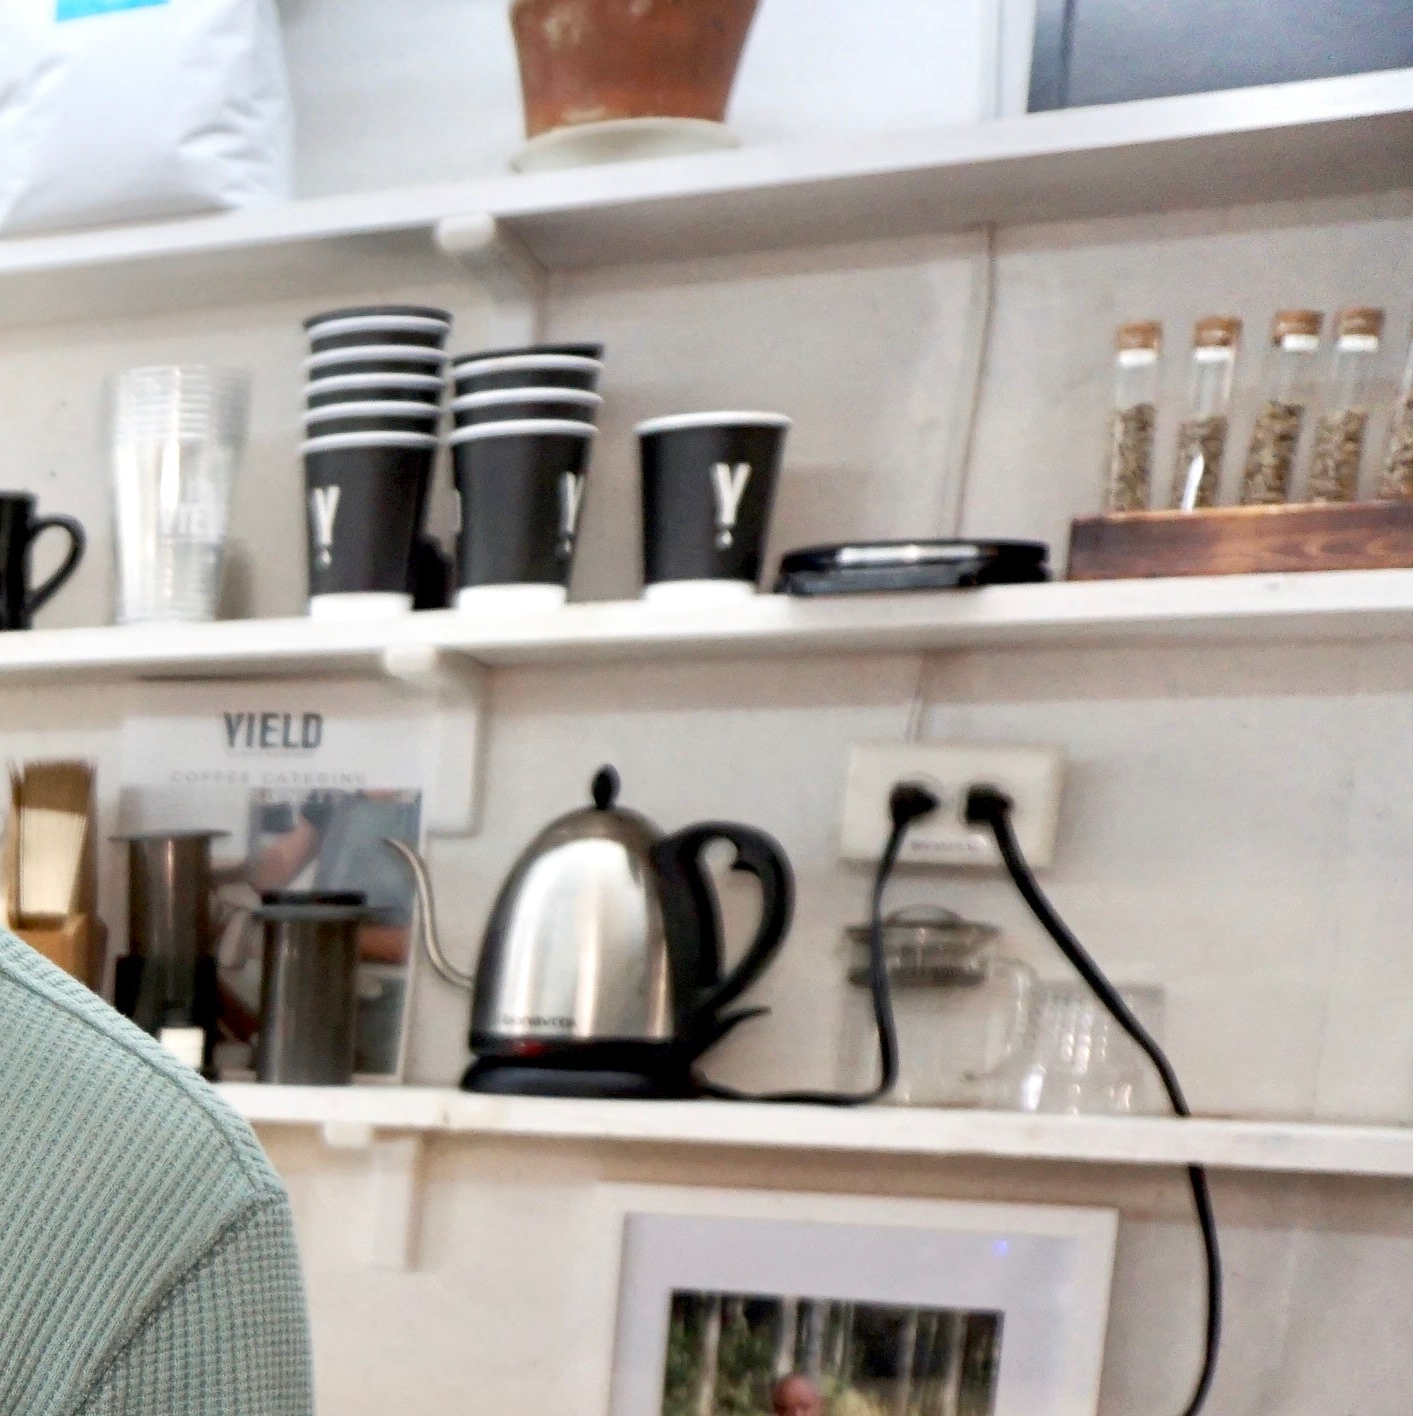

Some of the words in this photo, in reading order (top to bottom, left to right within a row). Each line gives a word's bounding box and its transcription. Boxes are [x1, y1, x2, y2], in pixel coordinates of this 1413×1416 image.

[224, 712, 323, 749] YIELD
[172, 771, 251, 784] COFFEE
[262, 771, 368, 785] CATERING
